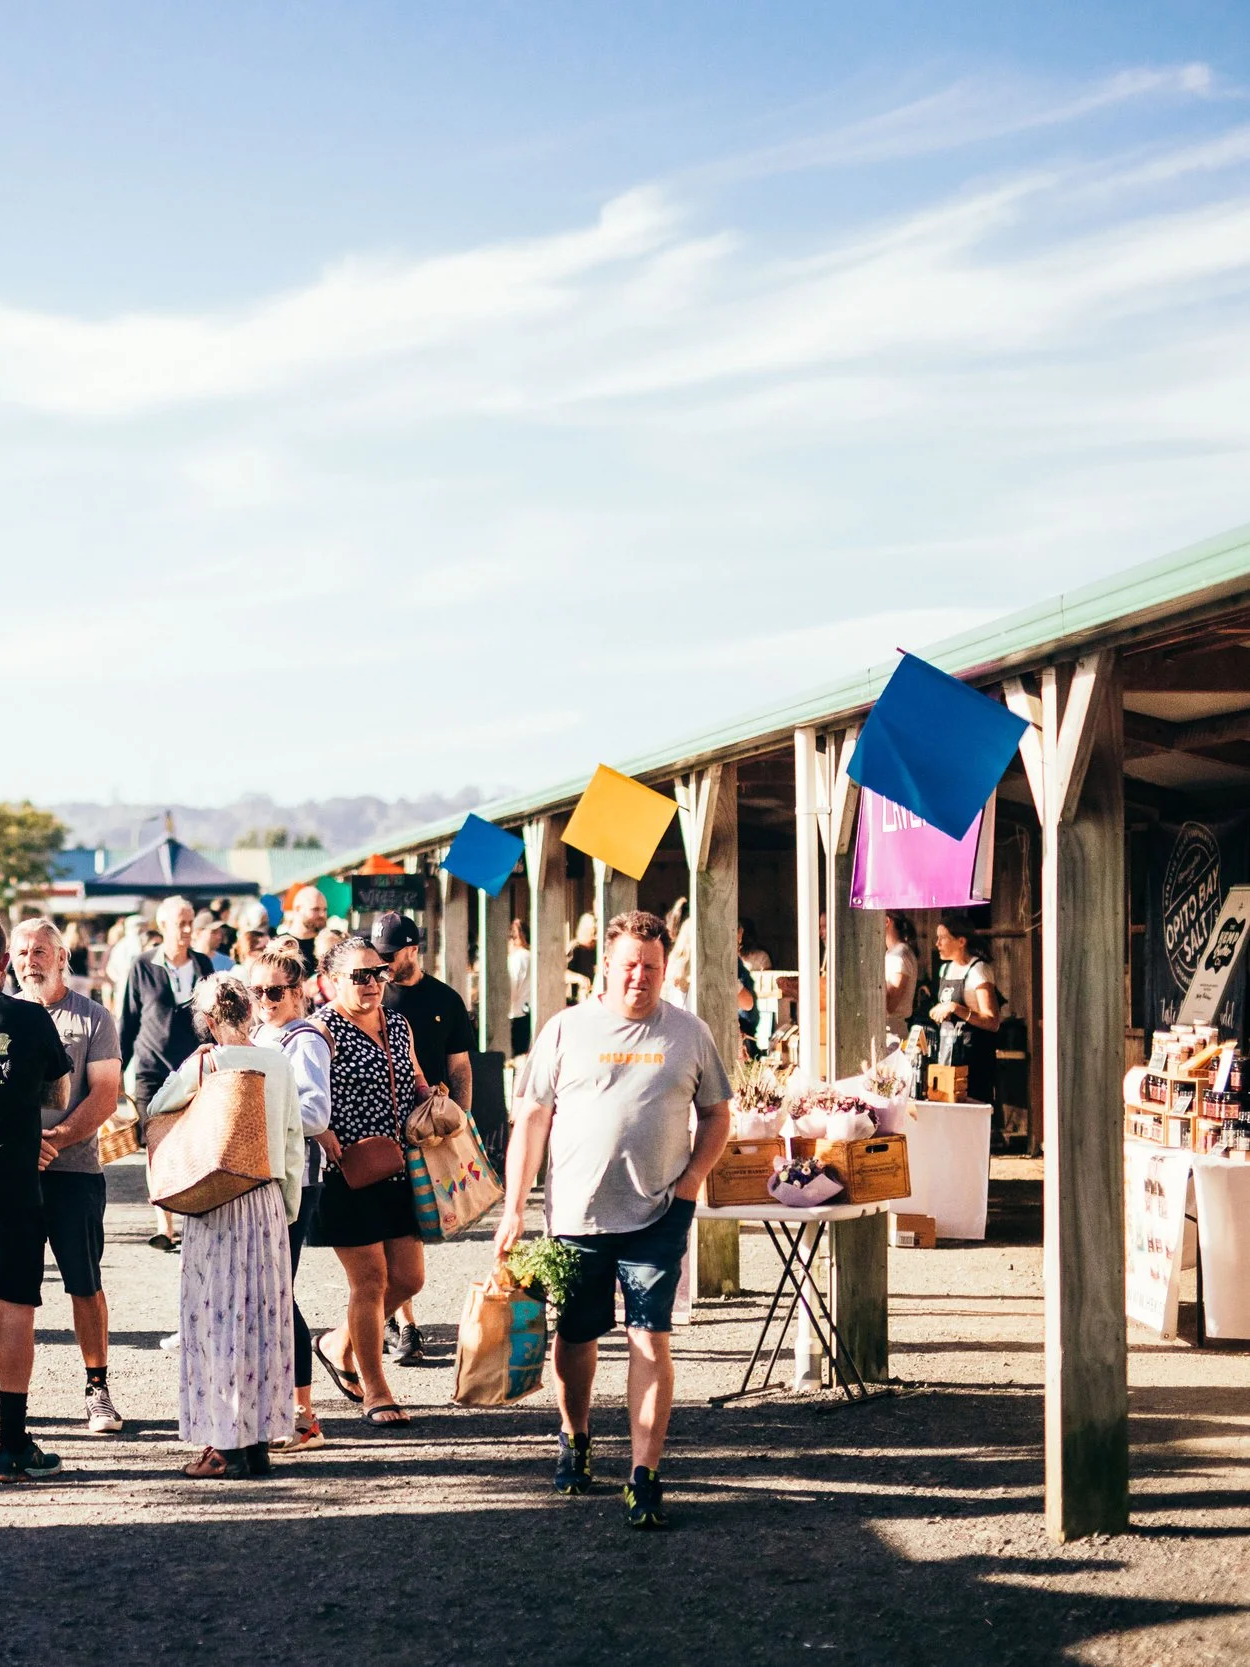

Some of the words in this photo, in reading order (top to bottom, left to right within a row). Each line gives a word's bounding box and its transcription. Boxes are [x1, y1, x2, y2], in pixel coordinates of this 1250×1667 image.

[1166, 894, 1197, 950] OPITO
[1198, 863, 1220, 910] BAY
[1183, 911, 1208, 962] SALT
[599, 1053, 665, 1065] HUFFER
